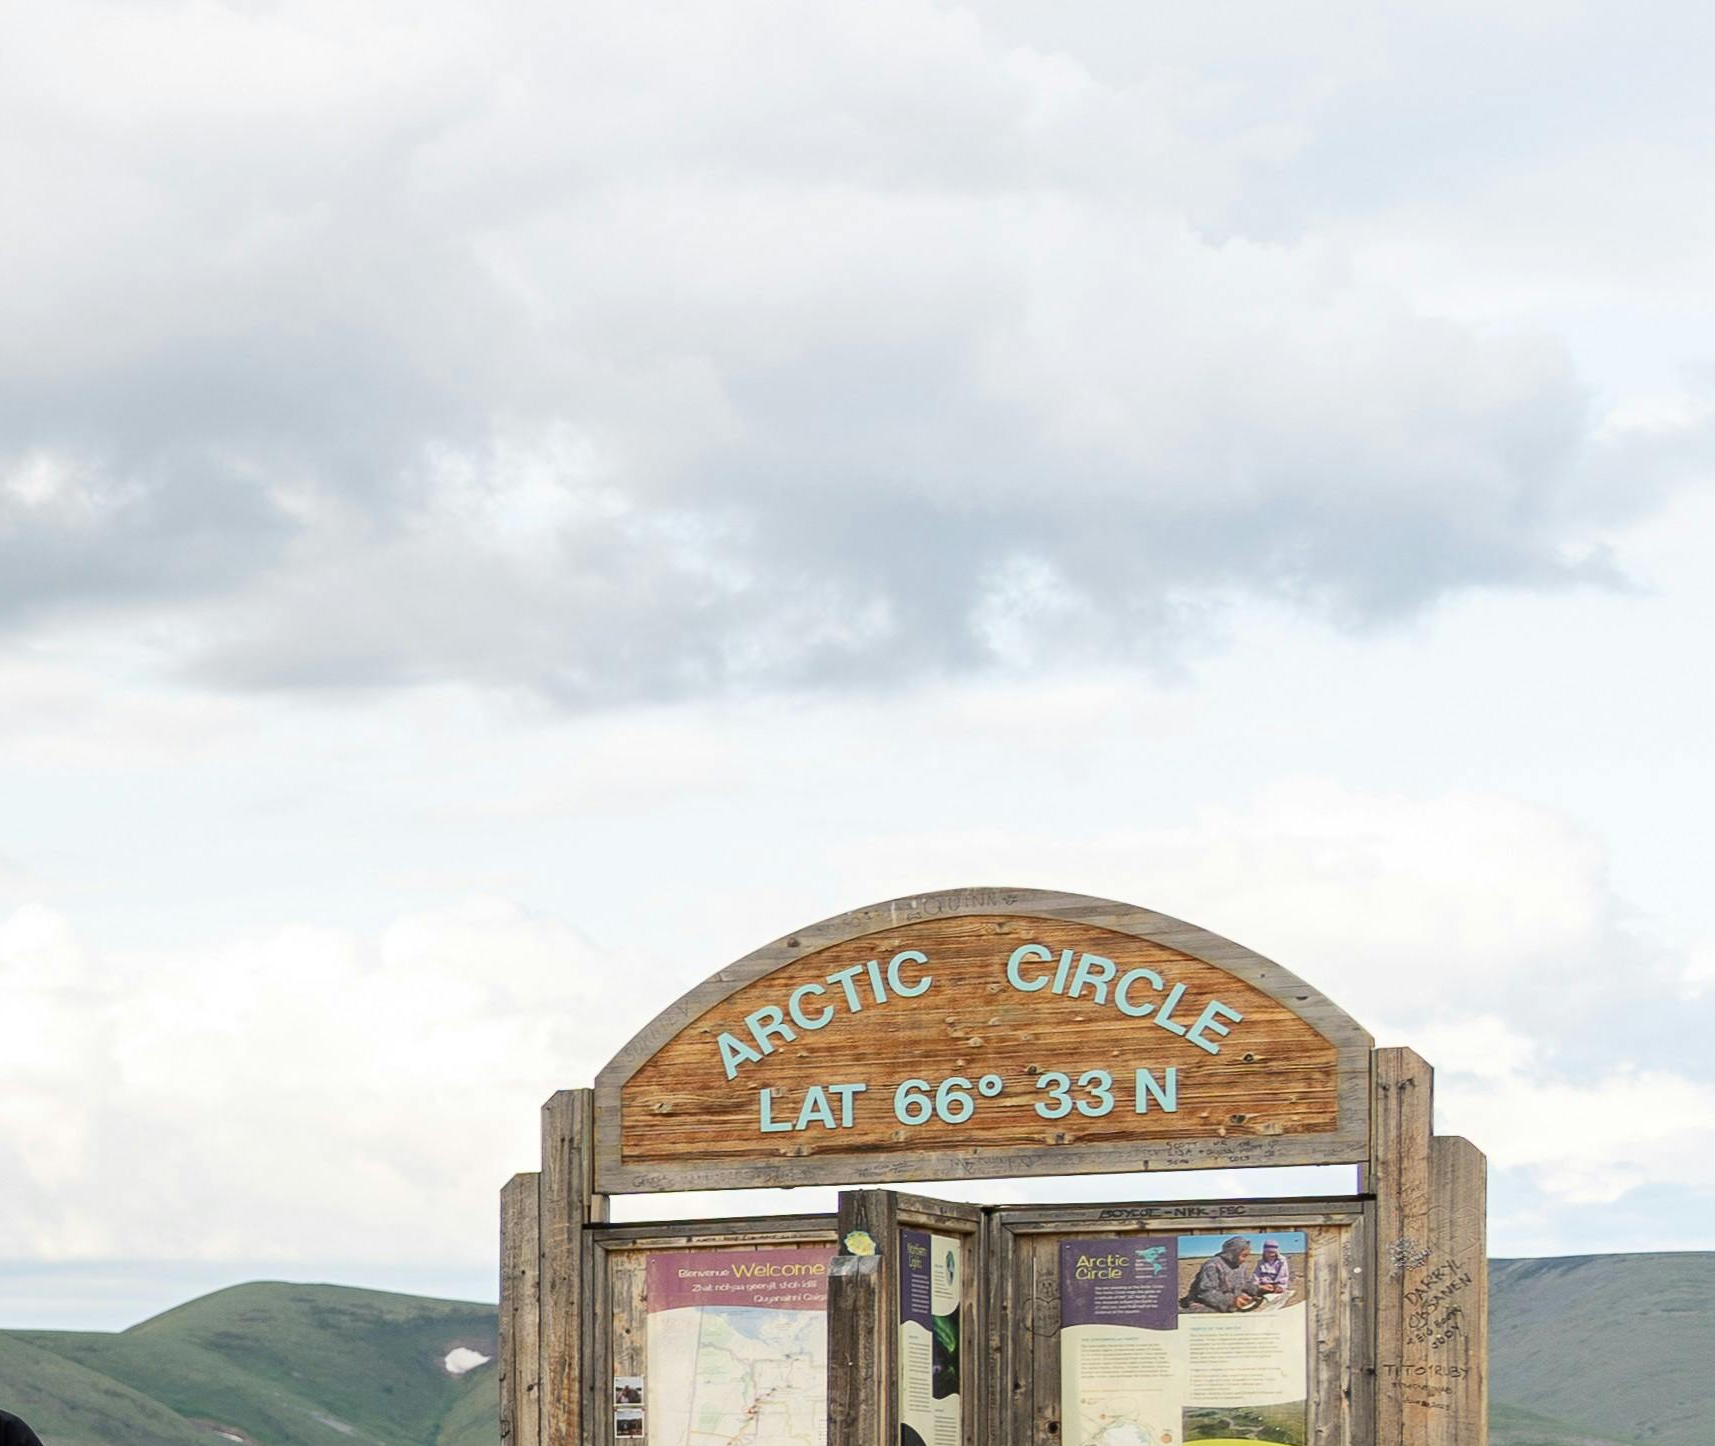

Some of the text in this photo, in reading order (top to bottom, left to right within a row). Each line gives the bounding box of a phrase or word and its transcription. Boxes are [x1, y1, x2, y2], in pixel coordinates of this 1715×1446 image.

[715, 949, 933, 1080] ARCTIC
[1007, 943, 1244, 1056] CIRCLE
[759, 1066, 1178, 1133] LAT 66° 33 N
[1075, 1254, 1131, 1268] Arctic
[731, 1262, 826, 1279] Welcome
[1075, 1266, 1123, 1280] Circle
